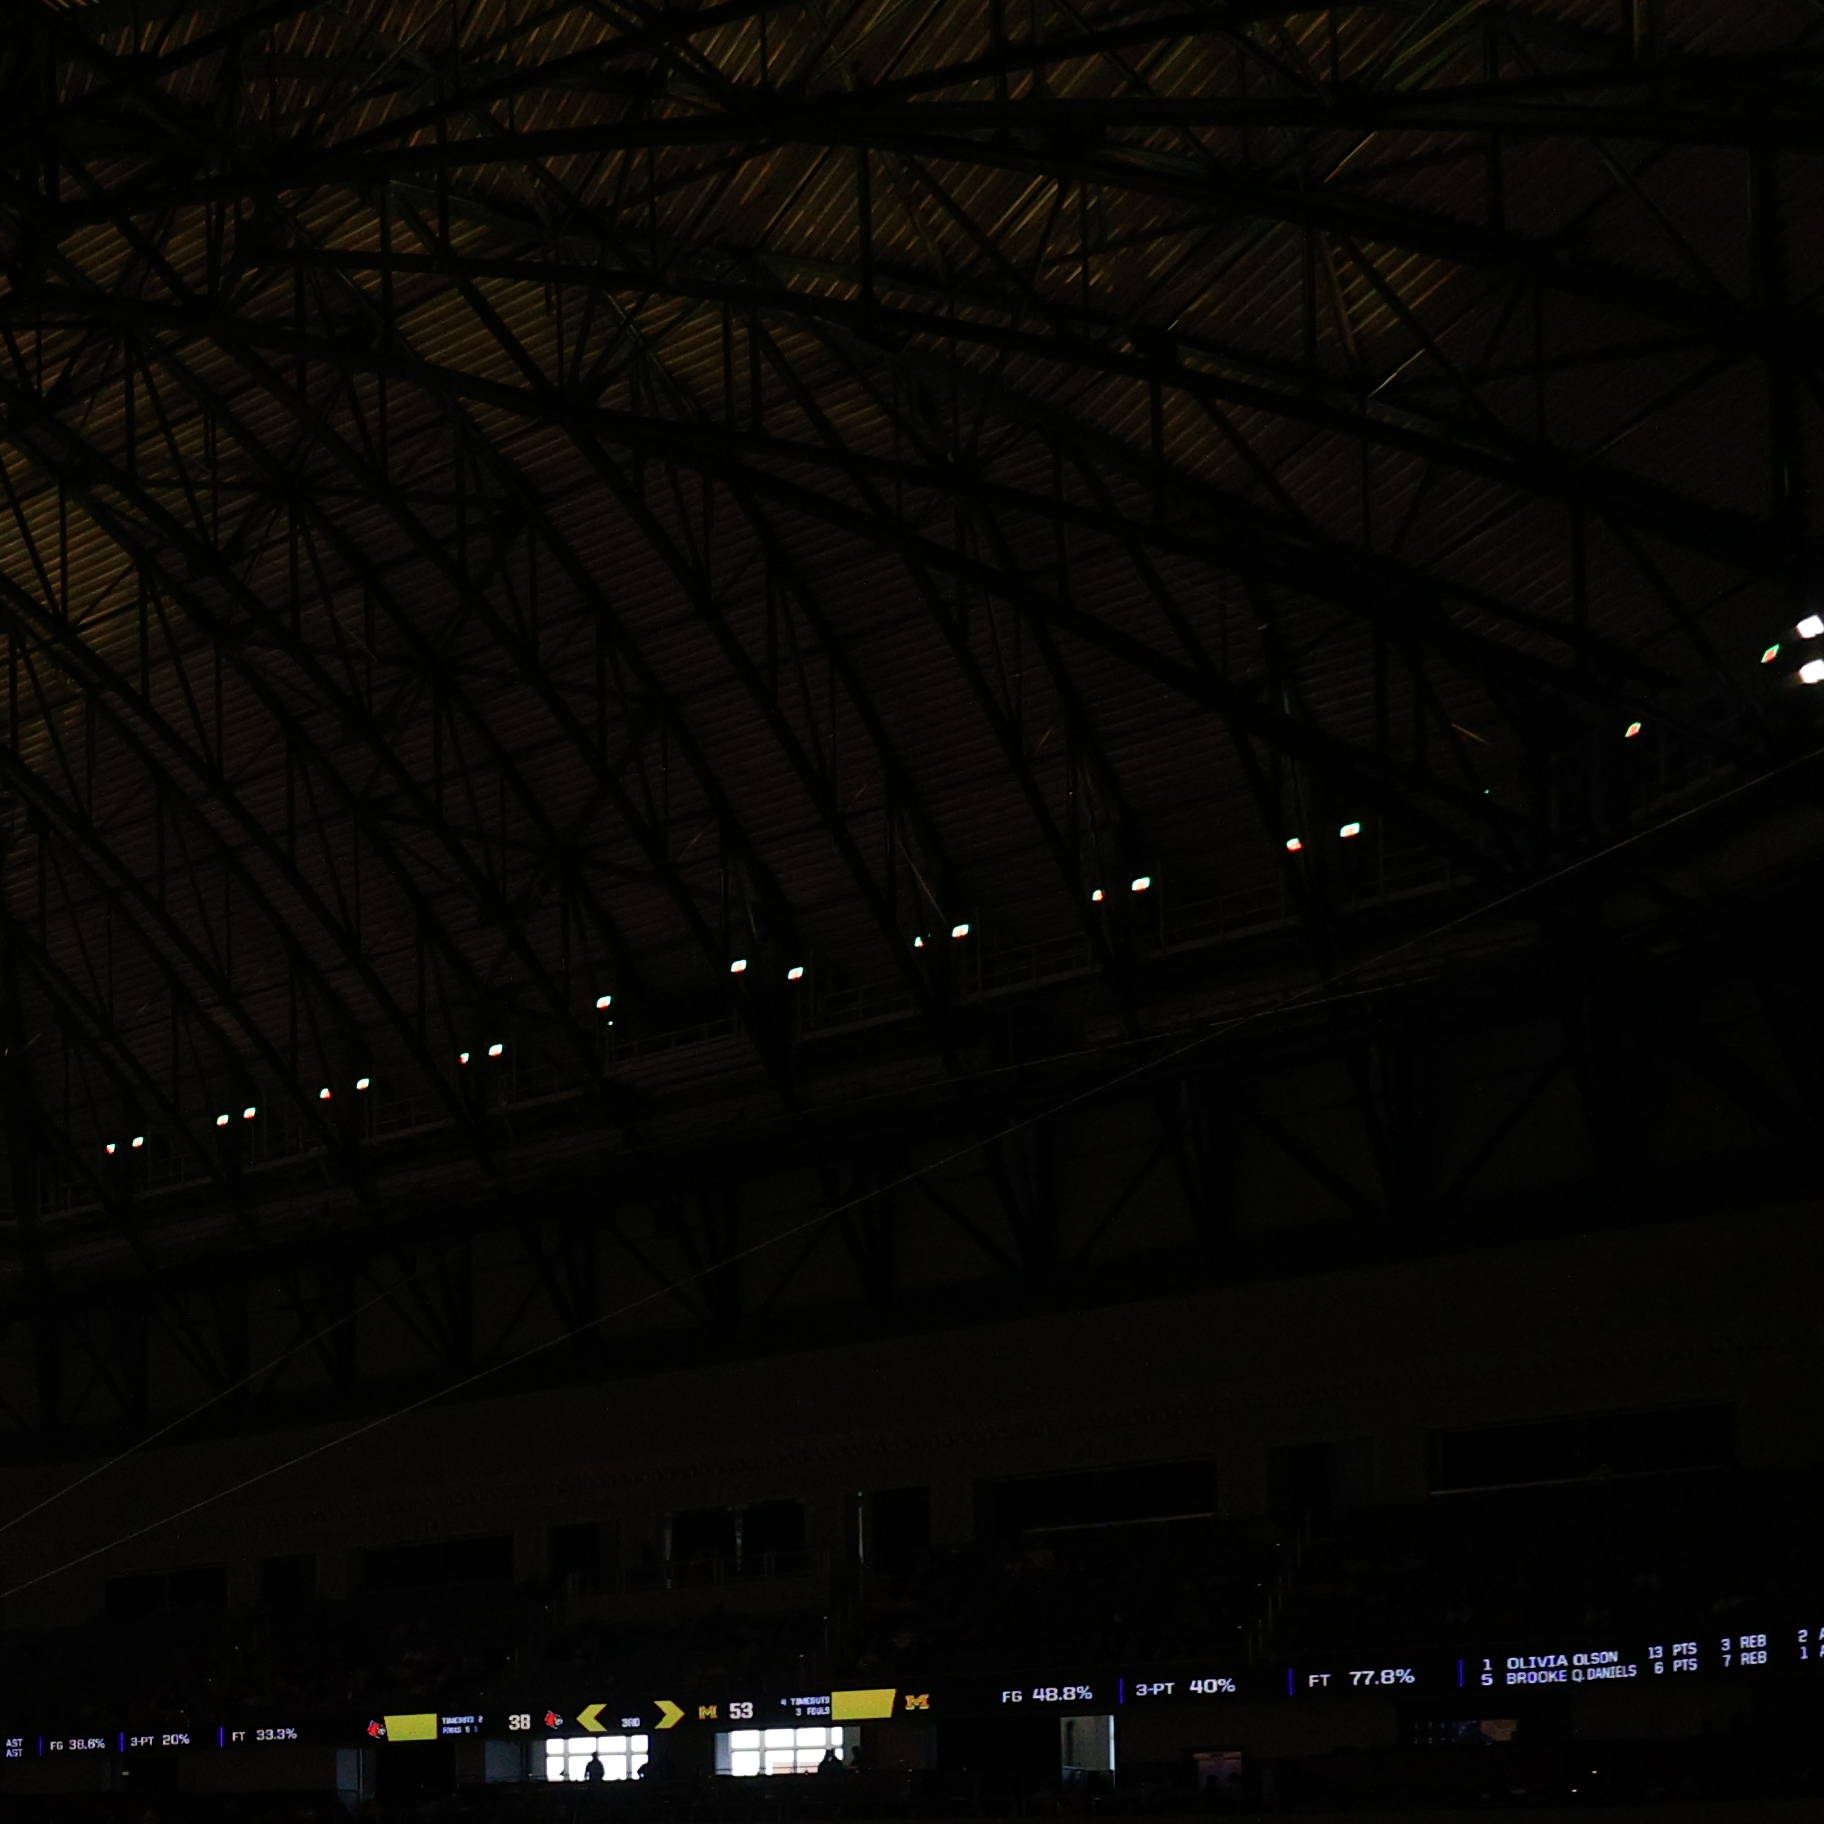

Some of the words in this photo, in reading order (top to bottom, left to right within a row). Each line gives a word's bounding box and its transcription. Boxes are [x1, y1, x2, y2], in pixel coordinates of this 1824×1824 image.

[1483, 1659, 1492, 1670] 1
[1506, 1656, 1568, 1670] OLIVIA
[1573, 1651, 1619, 1666] OLSON
[1649, 1646, 1662, 1659] 13
[1673, 1642, 1697, 1656] PTS
[1721, 1639, 1730, 1651] 3
[1740, 1634, 1766, 1648] REB
[1798, 1630, 1807, 1642] 2
[1482, 1674, 1493, 1685] 5
[1507, 1670, 1567, 1684] BROOKE
[1586, 1663, 1637, 1680] DANIELS
[1655, 1662, 1663, 1674] 6
[1673, 1658, 1697, 1671] PTS
[1722, 1655, 1731, 1667] 7
[1741, 1651, 1767, 1665] REB
[1801, 1646, 1808, 1659] 1
[1002, 1691, 1022, 1702] FG
[1033, 1686, 1092, 1701] 48.8%
[1136, 1683, 1174, 1695] 3-PT
[1190, 1679, 1235, 1693] 40%
[1309, 1674, 1330, 1687] FT
[1349, 1669, 1415, 1685] 77.8%
[509, 1714, 530, 1730] 38
[730, 1702, 753, 1719] 53
[51, 1741, 63, 1750] FG
[69, 1739, 105, 1749] 38.6%
[131, 1736, 154, 1746] 3-PT
[163, 1734, 190, 1745] 20%
[233, 1732, 245, 1741] FT
[257, 1728, 297, 1740] 33.3%
